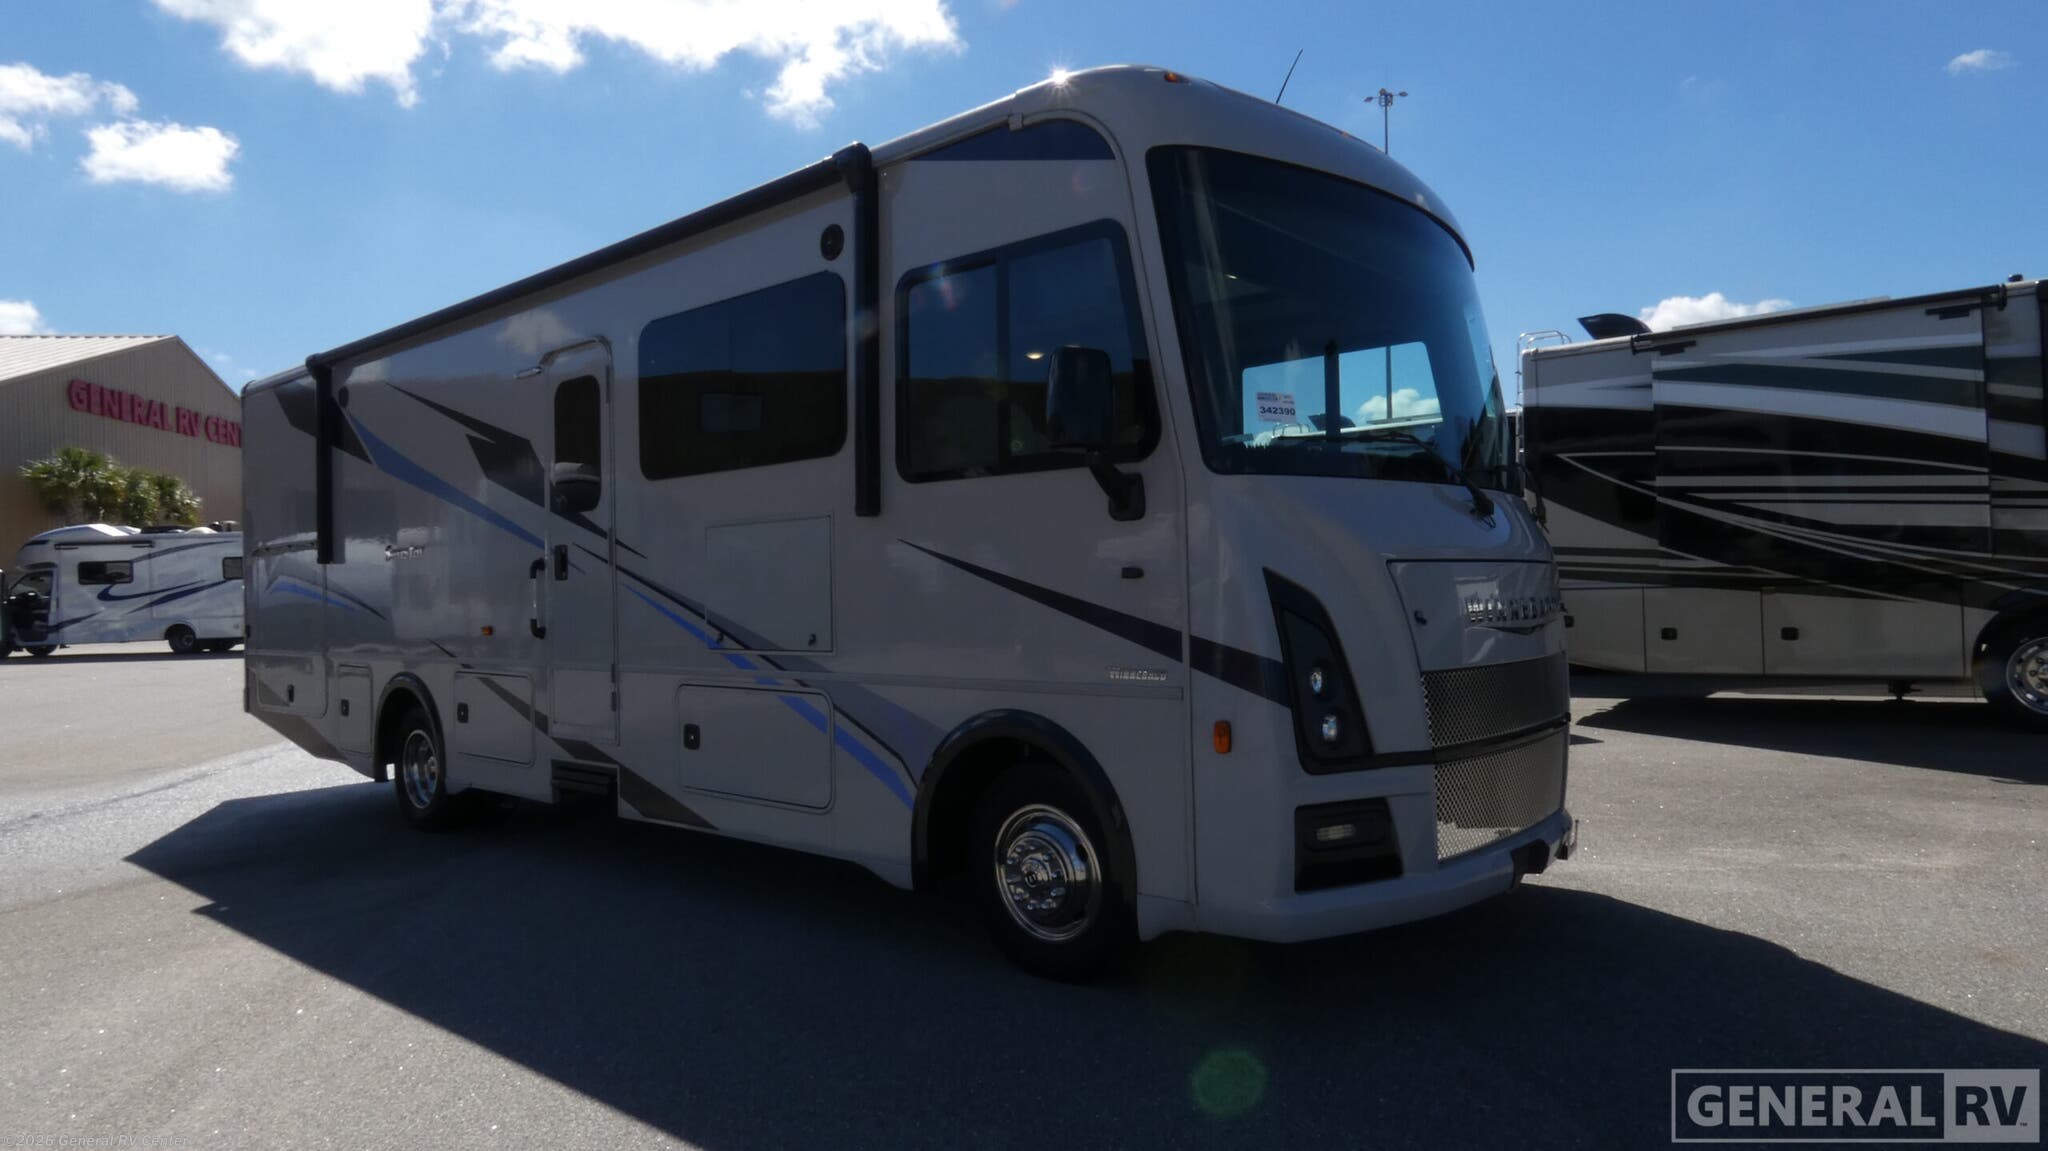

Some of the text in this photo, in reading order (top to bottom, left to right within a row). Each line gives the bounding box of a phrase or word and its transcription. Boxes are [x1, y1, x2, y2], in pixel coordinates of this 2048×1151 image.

[67, 379, 172, 431] GENERAL
[175, 408, 200, 437] RV
[1259, 406, 1296, 416] 342390
